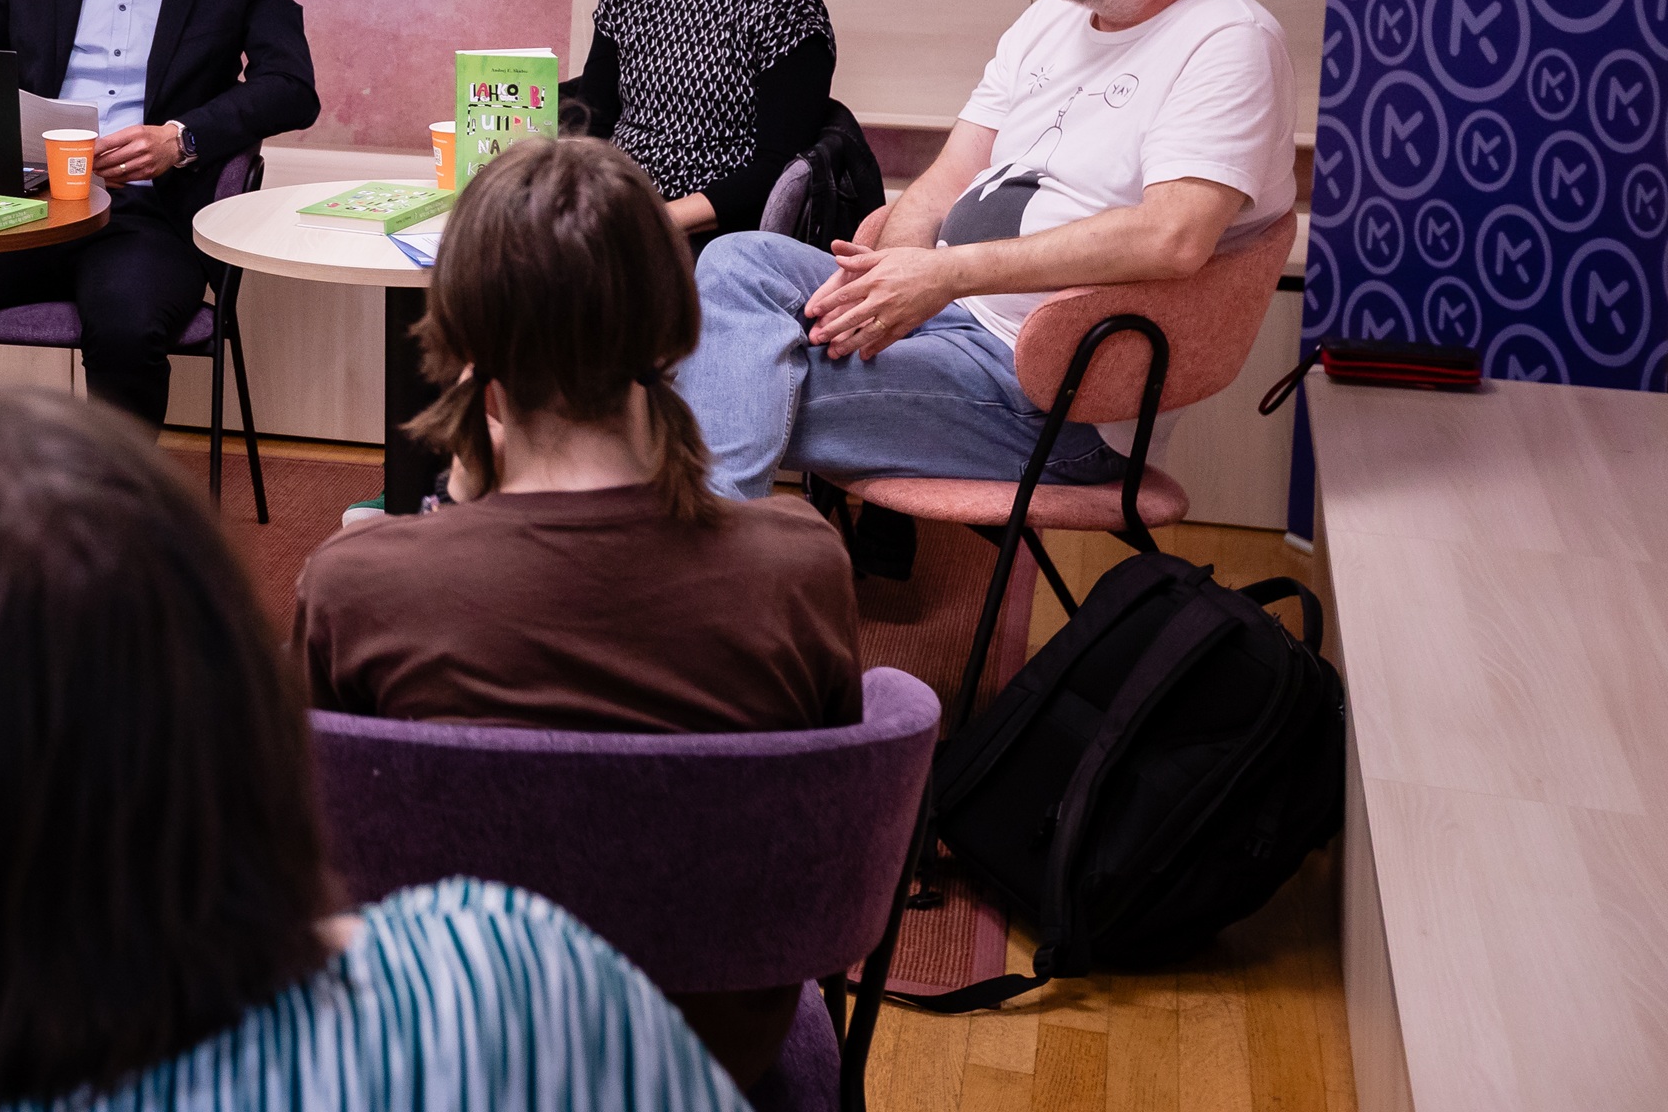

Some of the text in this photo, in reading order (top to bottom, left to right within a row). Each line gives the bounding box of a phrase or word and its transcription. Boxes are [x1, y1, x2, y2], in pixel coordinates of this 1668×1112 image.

[469, 82, 519, 102] LAHKO
[1112, 84, 1132, 97] YAY
[477, 138, 500, 154] NA
